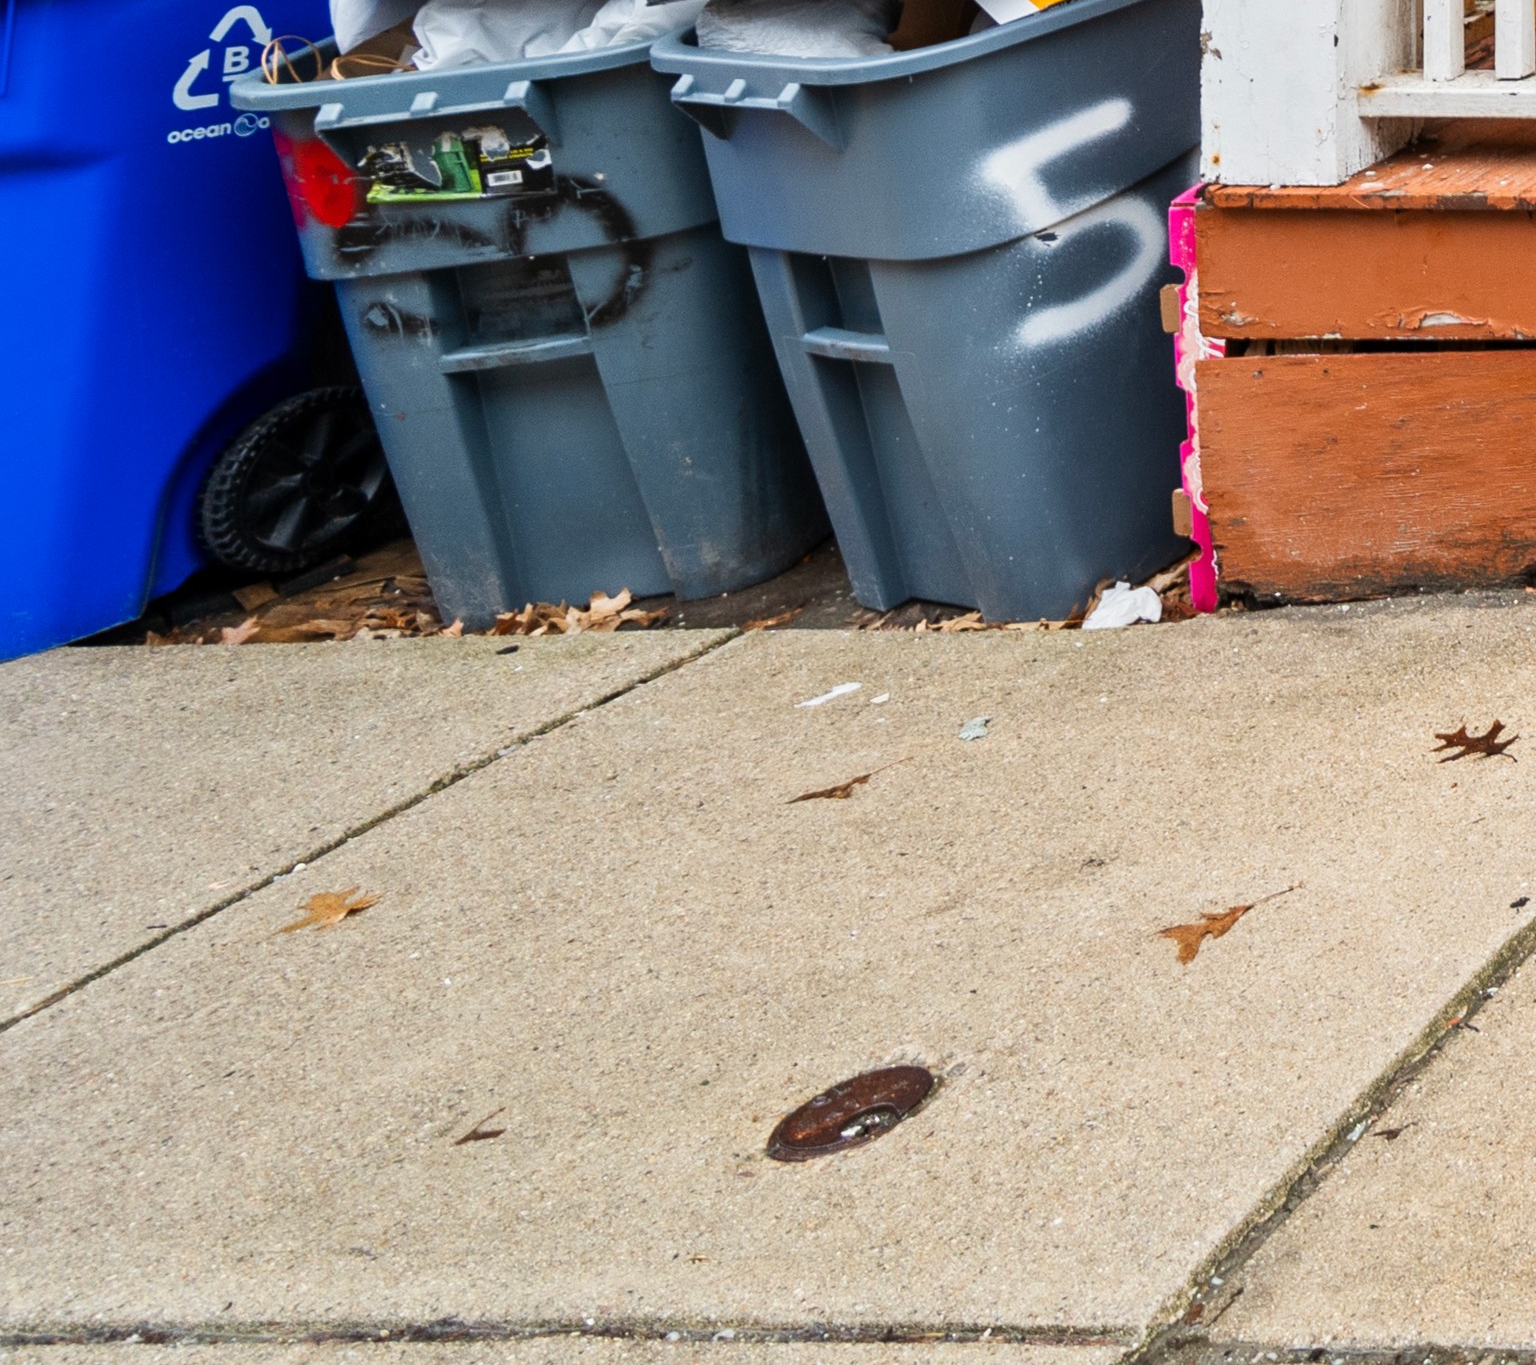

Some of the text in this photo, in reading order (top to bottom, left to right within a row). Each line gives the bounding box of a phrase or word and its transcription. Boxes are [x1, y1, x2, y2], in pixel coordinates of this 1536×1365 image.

[222, 45, 250, 74] B
[167, 122, 232, 144] ocean
[980, 96, 1166, 347] 5
